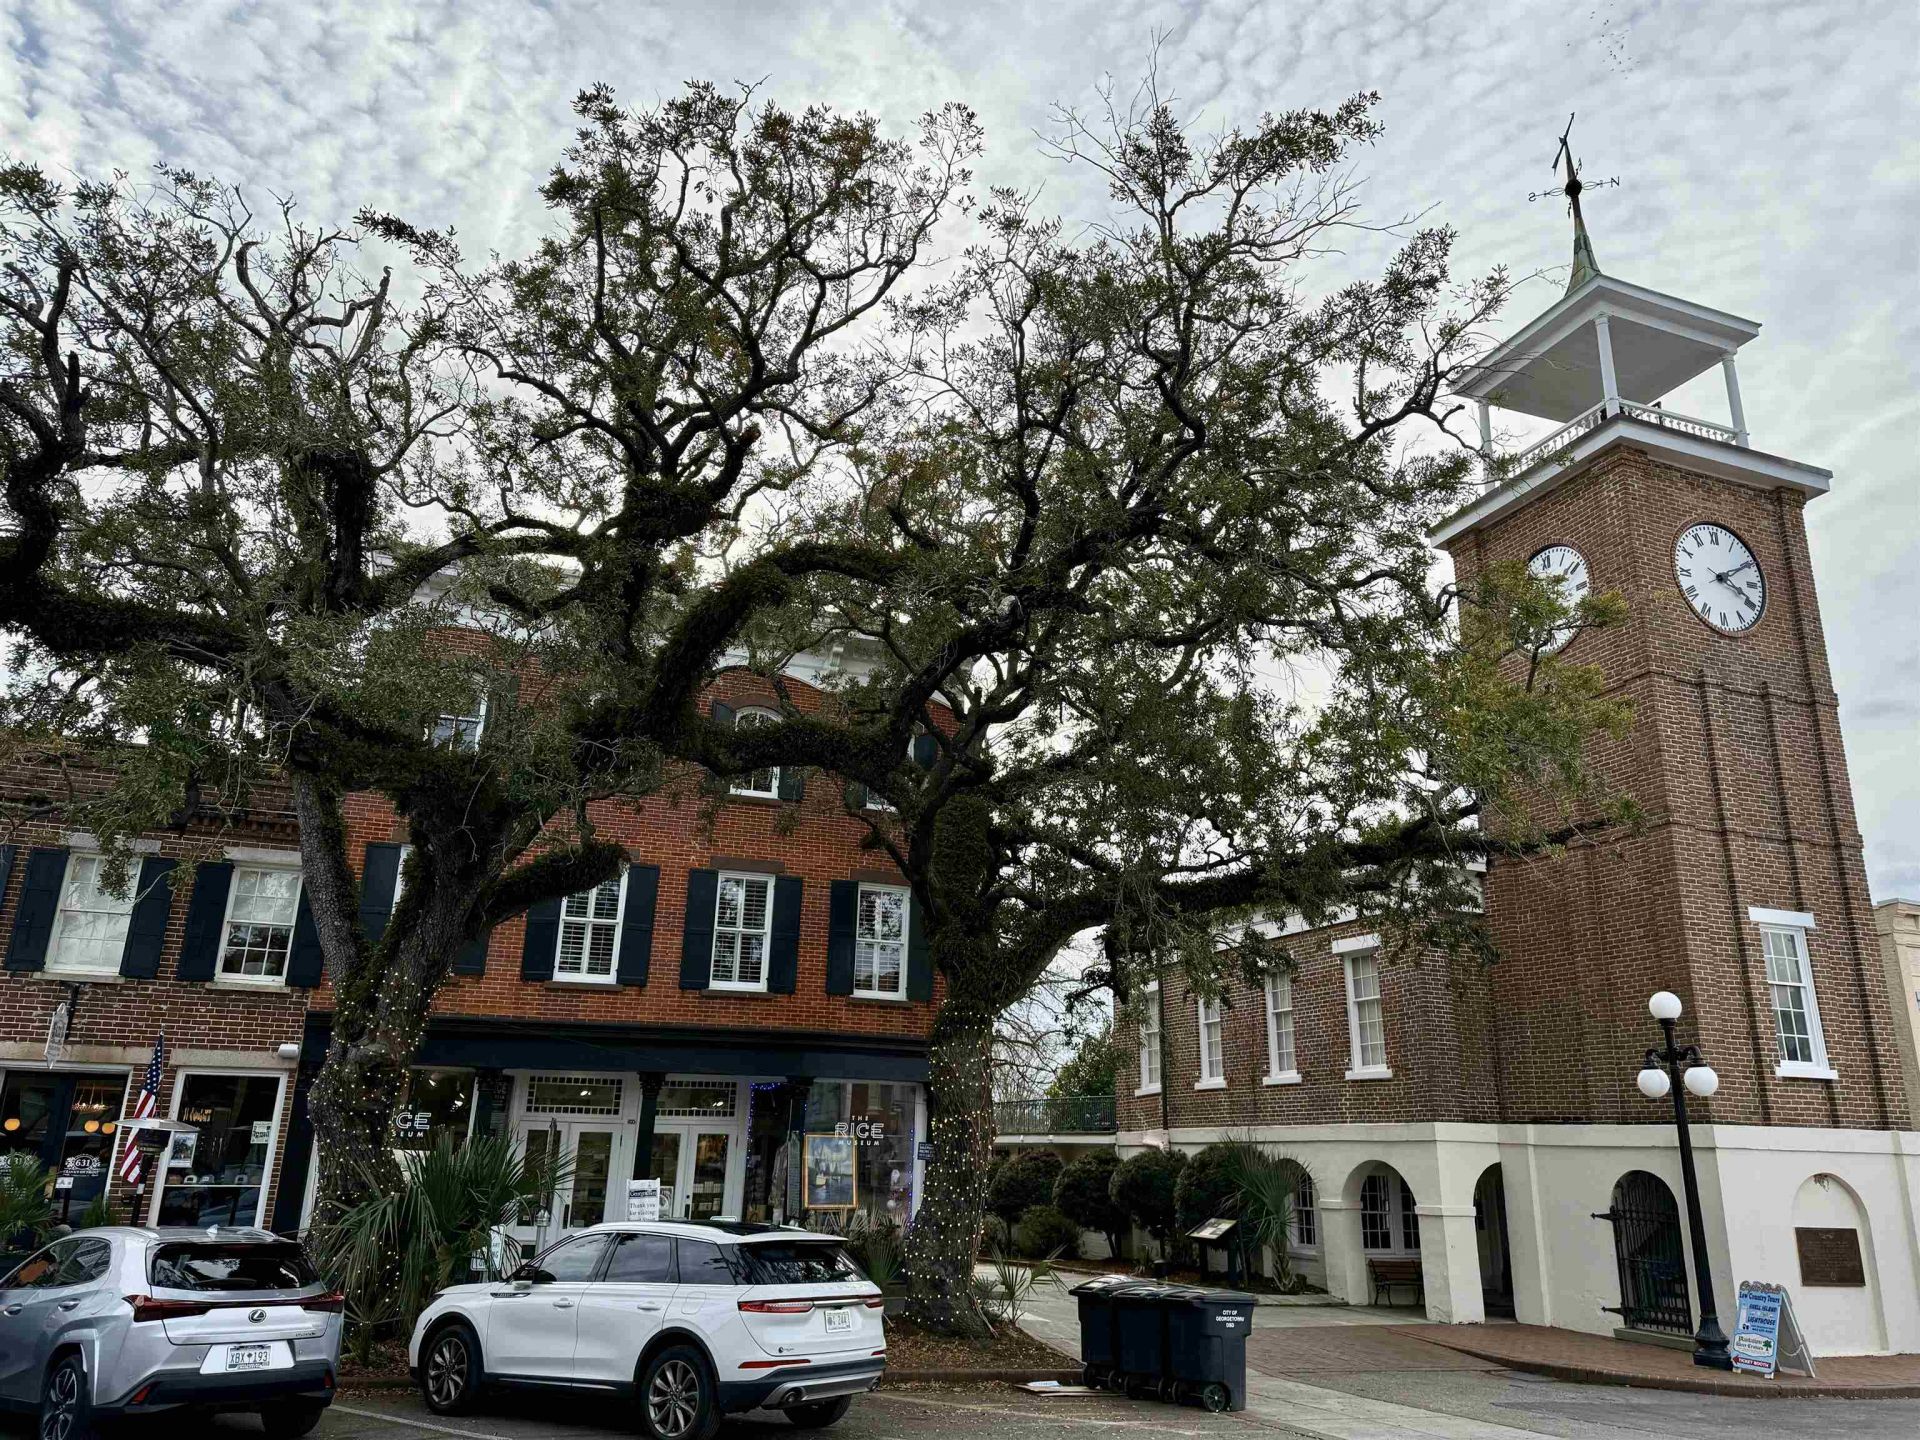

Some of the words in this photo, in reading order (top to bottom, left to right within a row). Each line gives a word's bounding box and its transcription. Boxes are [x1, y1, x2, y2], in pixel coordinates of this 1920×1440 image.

[1692, 533, 1704, 548] XI
[1709, 531, 1719, 546] XII
[1681, 546, 1694, 559] X
[1680, 567, 1692, 577] IX
[835, 1122, 884, 1139] RICE
[75, 1159, 91, 1167] 631
[1749, 1293, 1767, 1303] Country
[1768, 1295, 1779, 1303] Tours
[230, 1352, 245, 1364] XBX
[253, 1351, 268, 1363] 193
